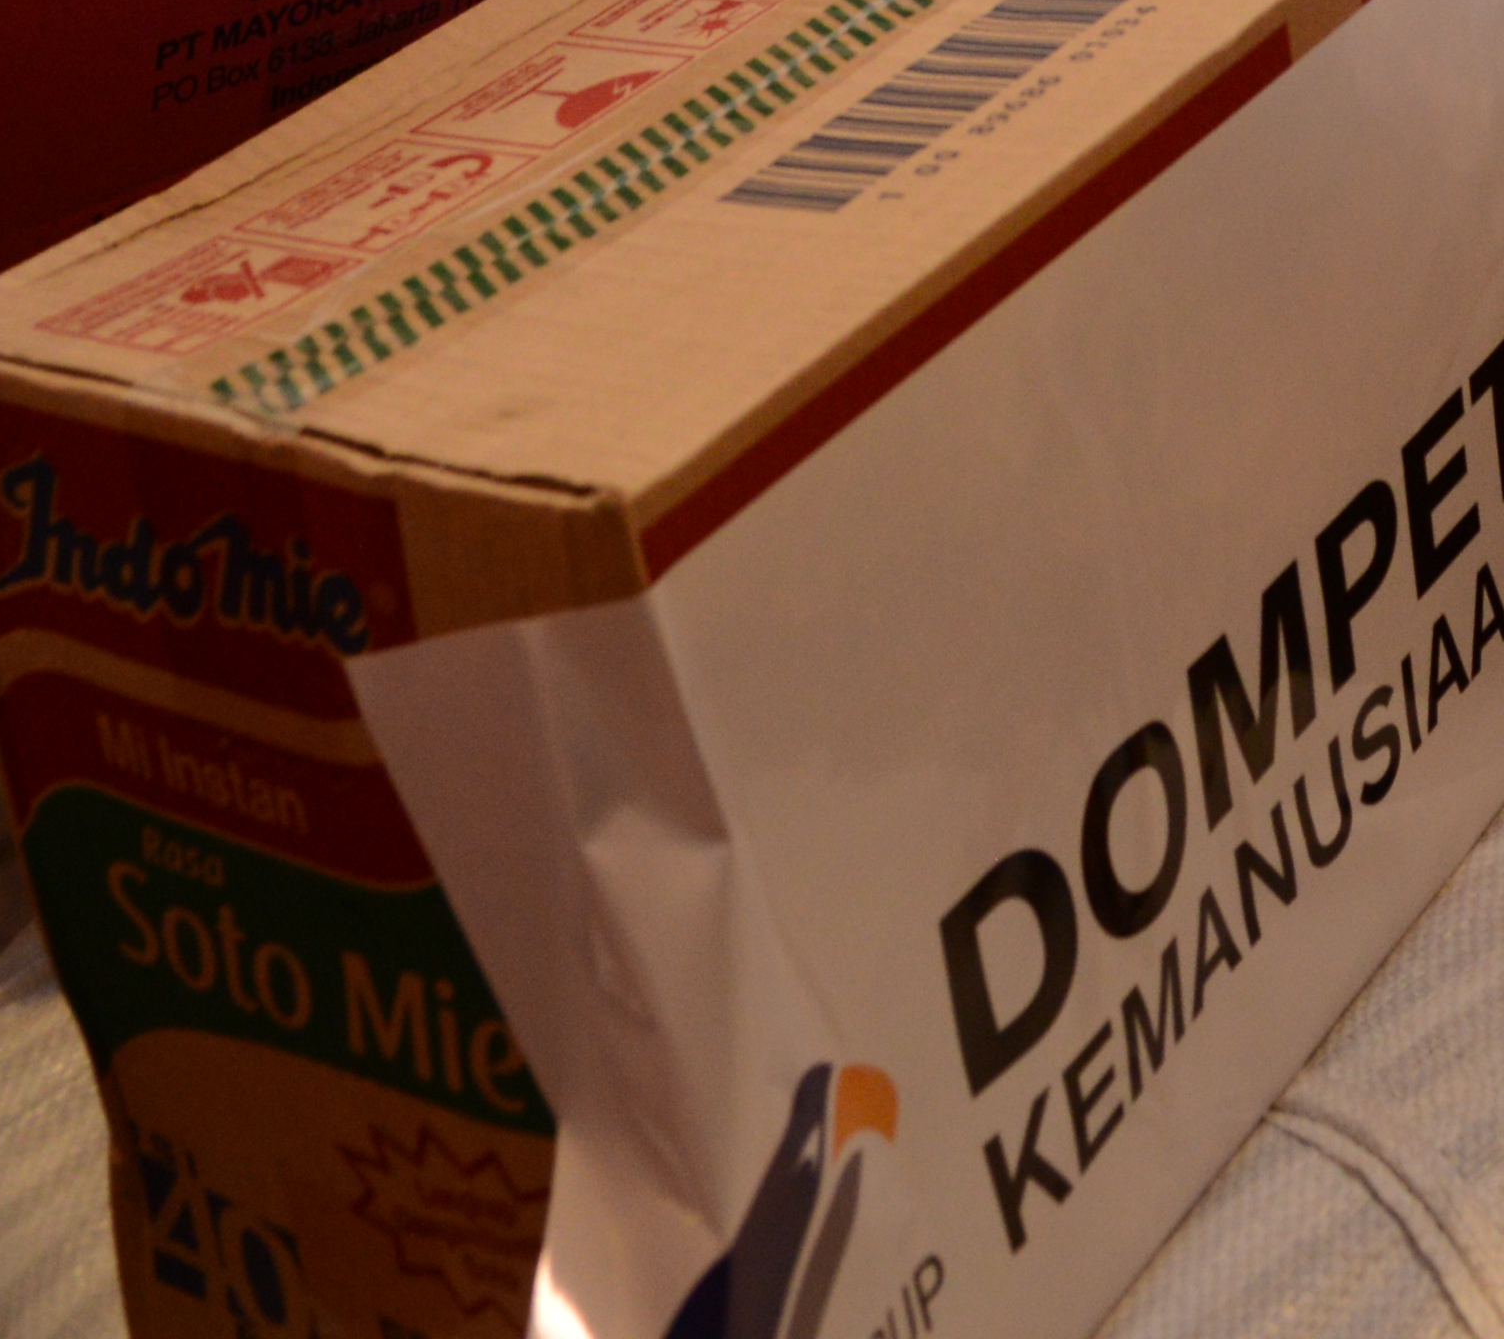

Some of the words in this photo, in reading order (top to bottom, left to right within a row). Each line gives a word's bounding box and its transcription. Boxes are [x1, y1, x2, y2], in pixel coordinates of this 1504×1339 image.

[151, 75, 199, 113] PO
[206, 56, 261, 94] Box
[346, 1, 441, 50] Jakarta
[155, 30, 206, 71] PT
[96, 709, 153, 781] Mi
[156, 734, 310, 835] Instan
[141, 824, 226, 887] Rasa
[106, 859, 313, 1033] Soto
[341, 950, 526, 1114] Mie
[868, 1252, 945, 1339] UP
